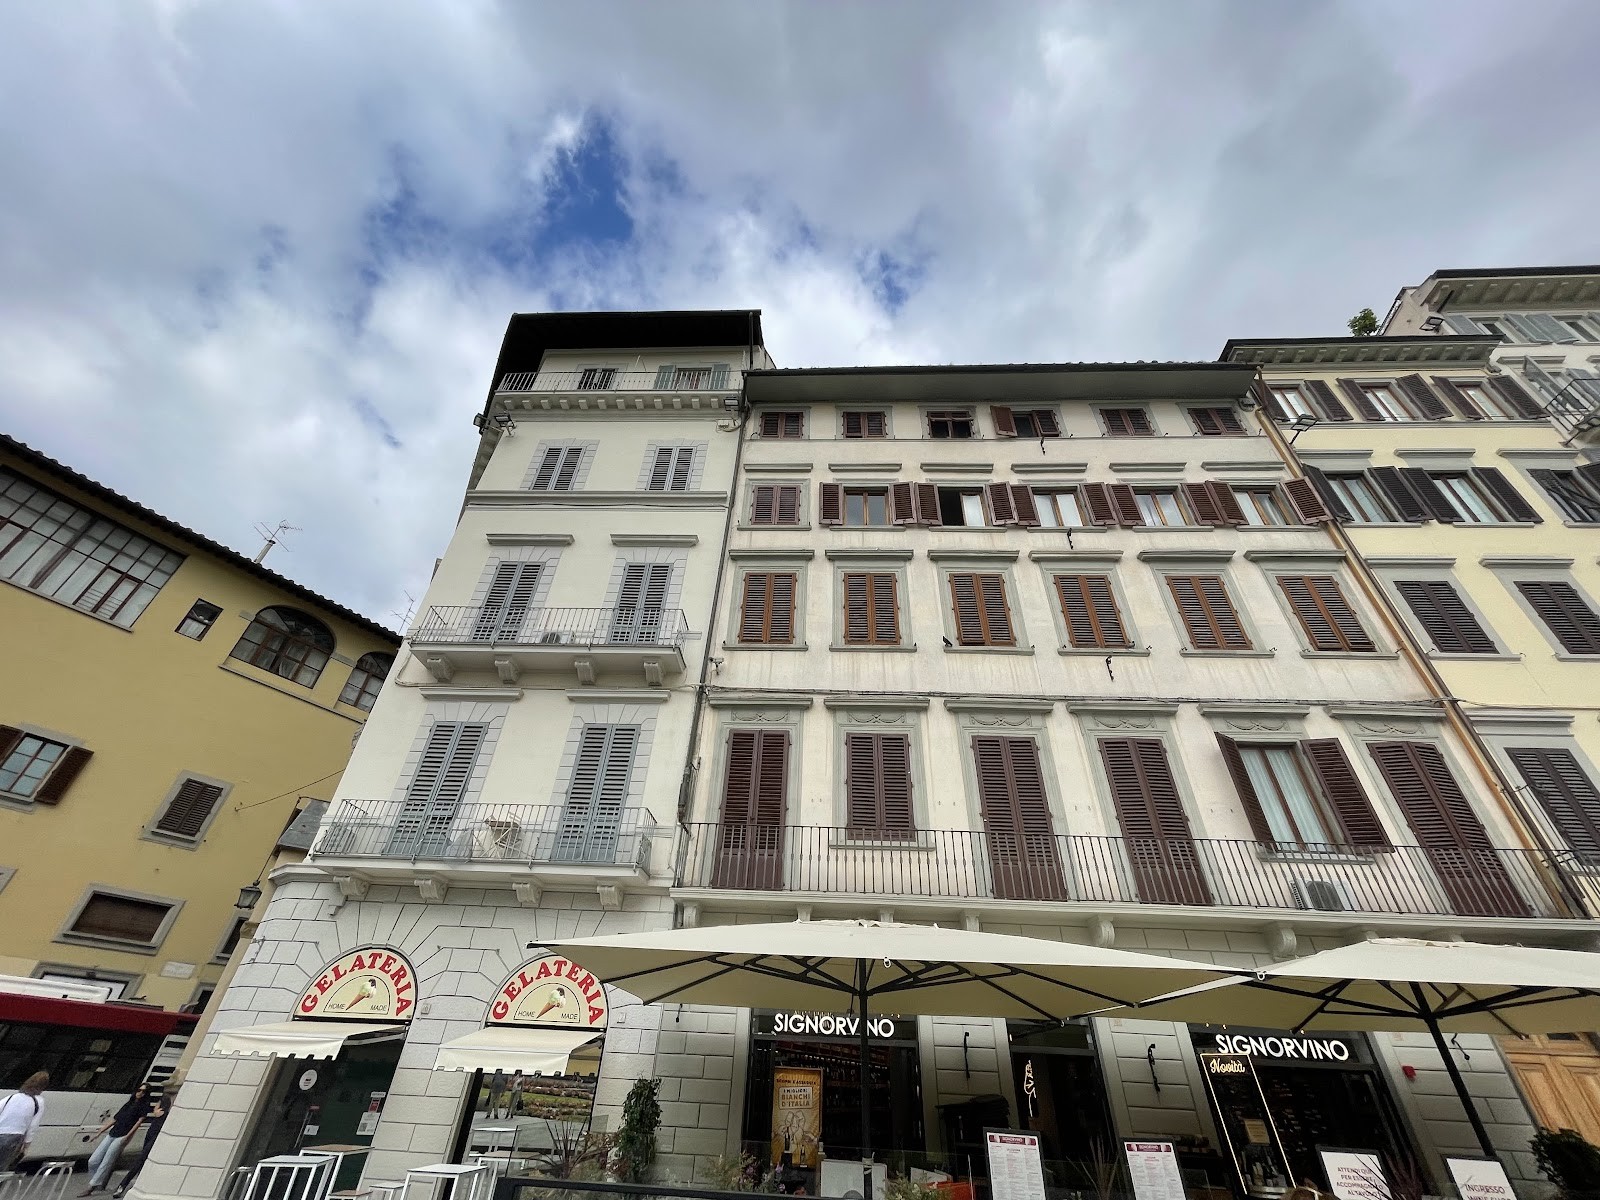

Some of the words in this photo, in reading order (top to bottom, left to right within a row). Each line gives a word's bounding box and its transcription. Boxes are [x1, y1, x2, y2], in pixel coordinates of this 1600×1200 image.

[301, 952, 412, 1017] GELATERIA
[492, 959, 605, 1026] GELATERIA
[773, 1013, 895, 1038] SIGNORVNO
[1215, 1033, 1350, 1061] SIGNORVINO
[1209, 1058, 1246, 1074] Novità
[1464, 1184, 1506, 1194] INGRESSO
